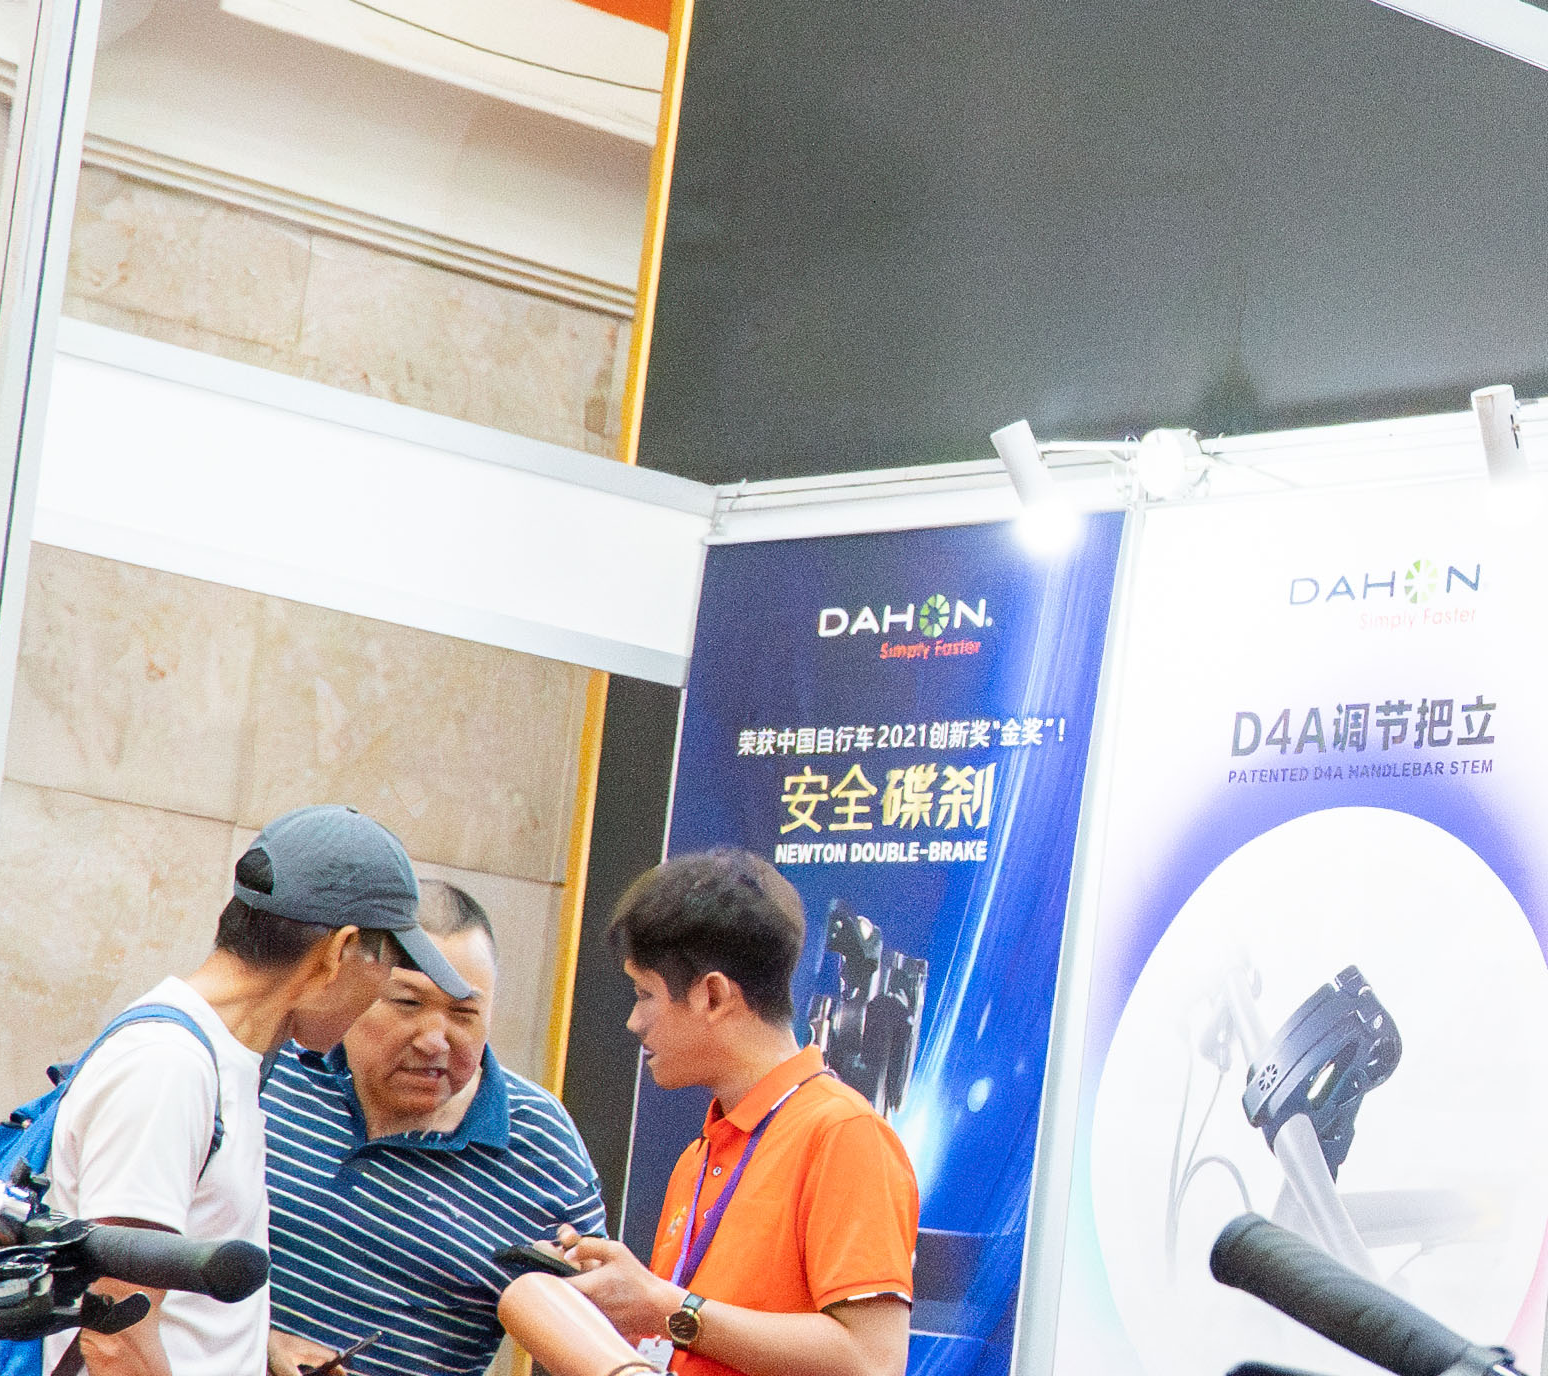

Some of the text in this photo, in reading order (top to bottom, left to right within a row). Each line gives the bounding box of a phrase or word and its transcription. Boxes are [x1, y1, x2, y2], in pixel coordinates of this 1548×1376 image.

[1289, 559, 1481, 606] DAHON
[818, 593, 988, 638] DAHON
[1230, 694, 1497, 757] D4A调节把立
[1228, 758, 1494, 784] PATENTED D4A HANDLEBAR STEM
[779, 762, 997, 835] 安全碟刹
[774, 839, 988, 865] NEWTON DOUBLE-BRAKE
